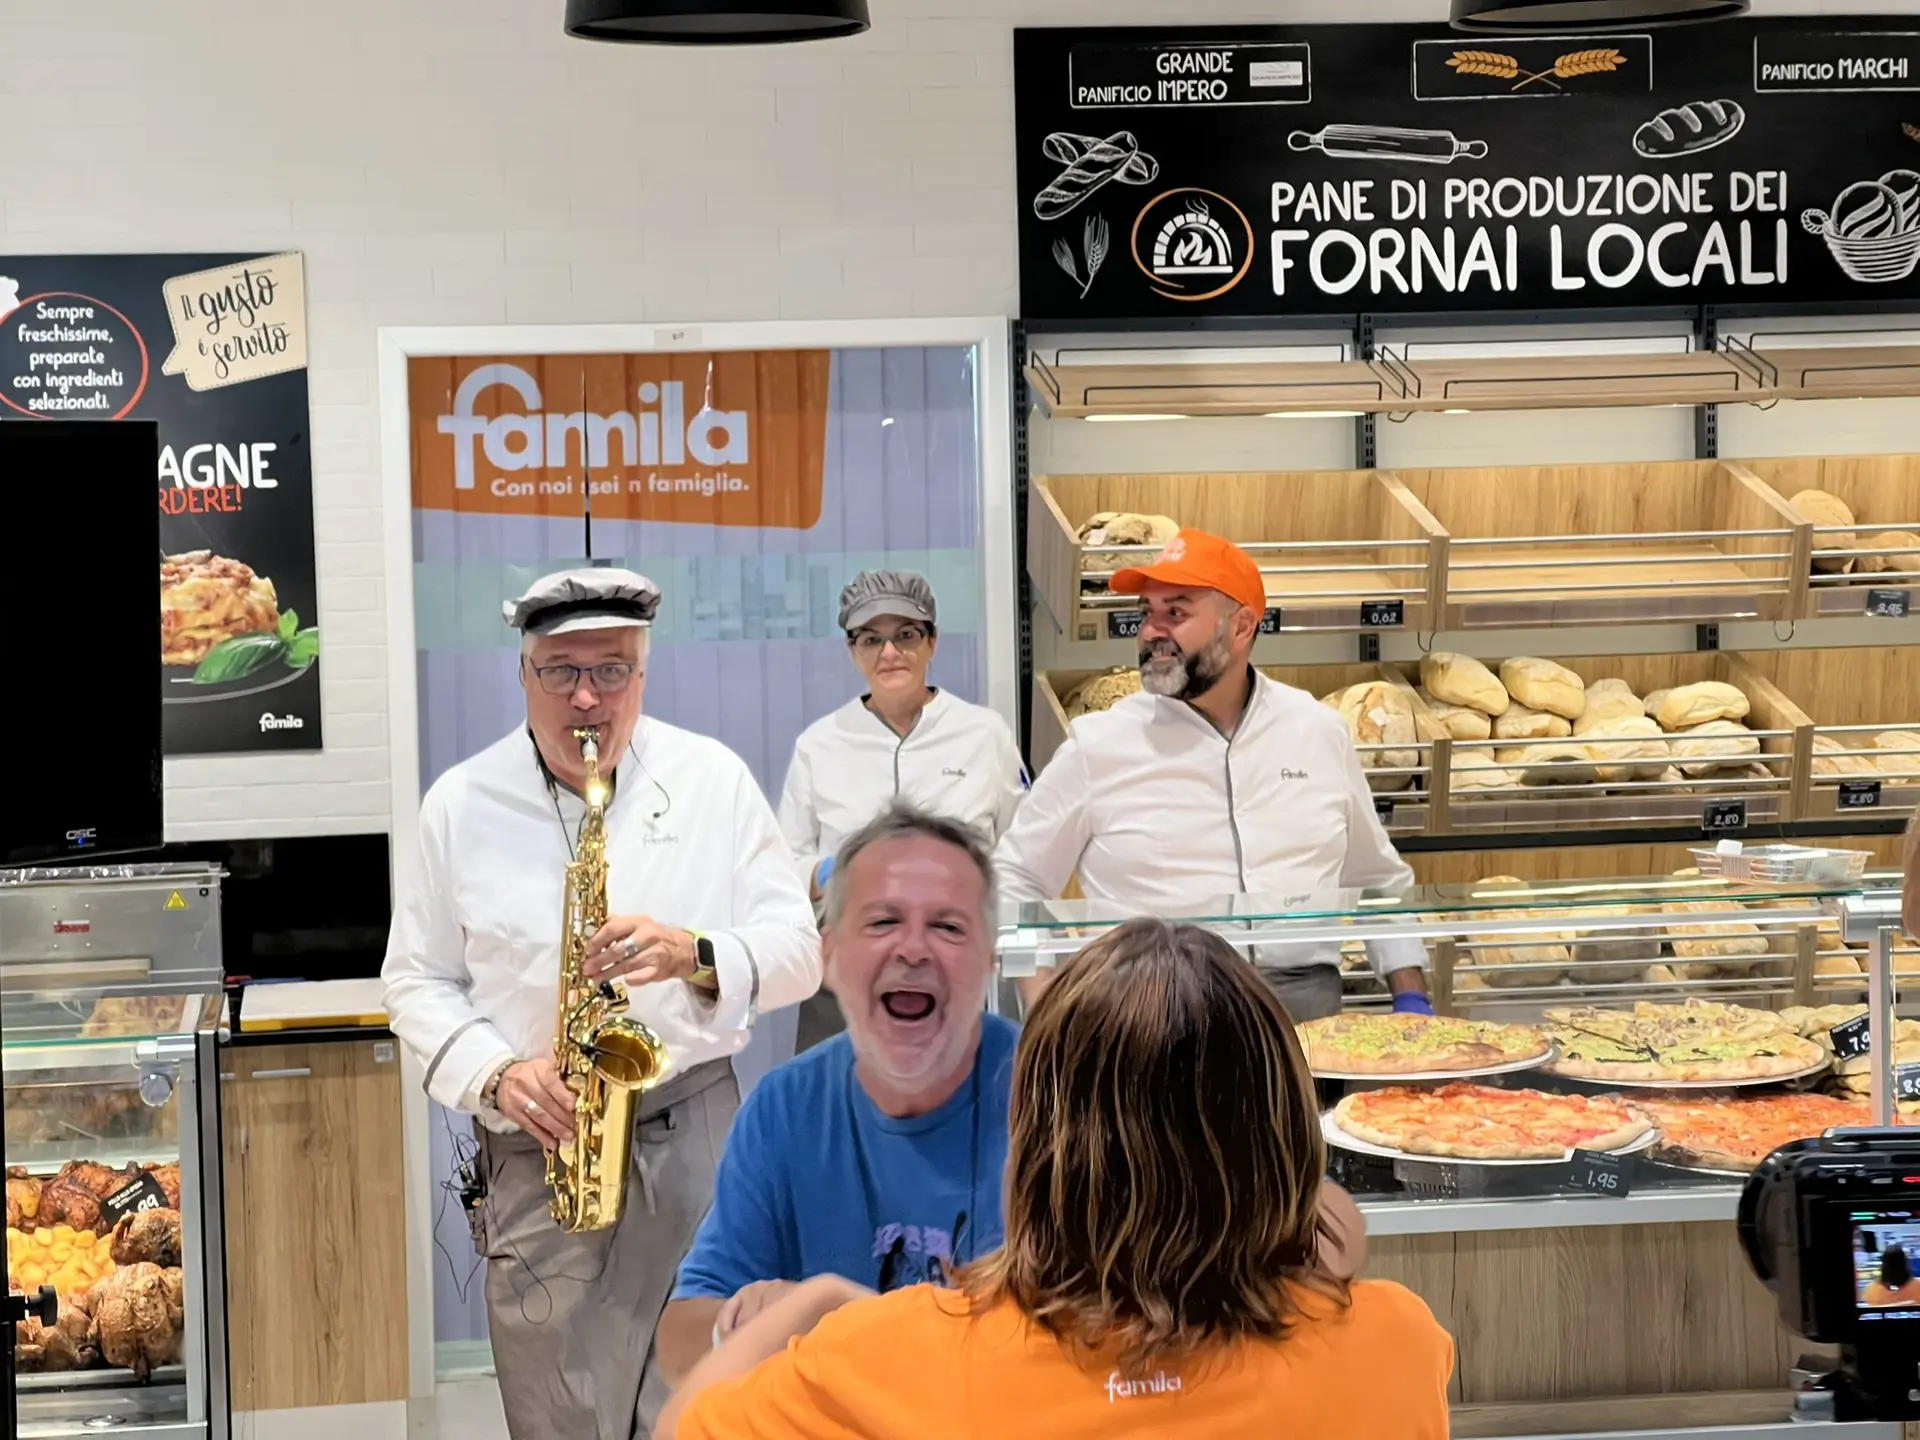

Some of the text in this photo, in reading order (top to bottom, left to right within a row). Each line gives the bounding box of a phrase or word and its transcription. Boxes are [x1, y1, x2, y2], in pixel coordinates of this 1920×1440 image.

[1156, 51, 1234, 75] GRANDE
[1762, 57, 1909, 80] PANIFICIO MARCHI
[1078, 79, 1228, 104] PANIFICIO IMPERO
[1271, 170, 1788, 222] PANE DI PRODUZIONE DEI
[1270, 218, 1788, 296] FORNAI LOCALI
[36, 301, 94, 325] Sempre
[180, 268, 279, 335] Il gusto
[18, 323, 113, 343] freschissime,
[29, 345, 105, 371] preparate
[213, 322, 291, 379] servito
[13, 368, 123, 395] con ingredienti
[28, 391, 110, 410] selezionati.
[437, 363, 748, 489] famila
[158, 442, 278, 490] AGNE
[491, 477, 534, 496] Con
[539, 475, 572, 493] noi
[648, 473, 749, 497] famiglia.
[159, 484, 242, 514] RDERE!
[259, 712, 304, 732] famila
[1588, 1170, 1618, 1189] 1,95
[1103, 1370, 1182, 1403] famila
